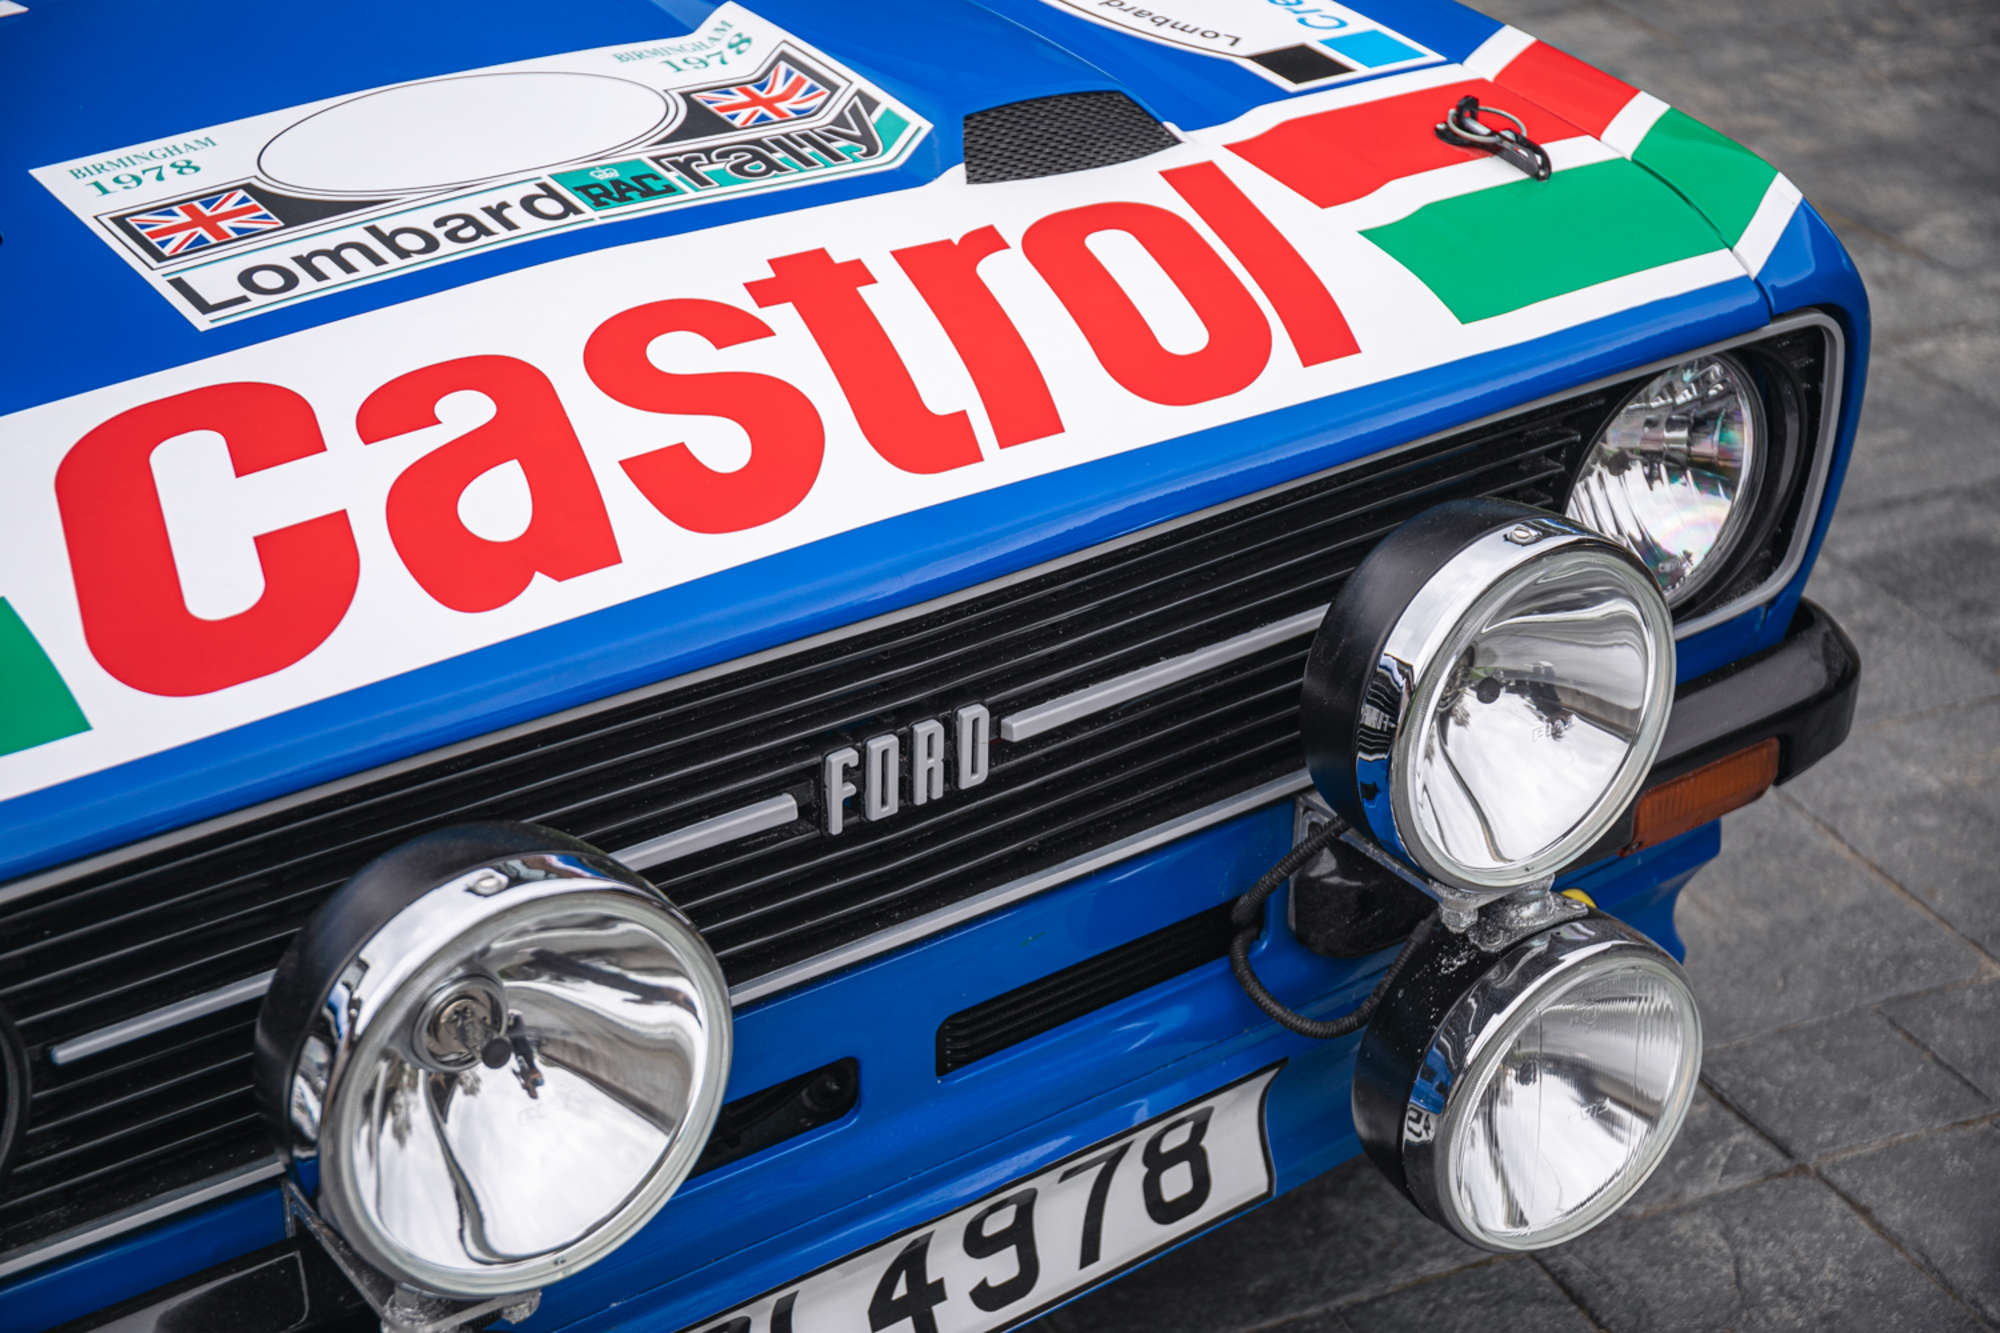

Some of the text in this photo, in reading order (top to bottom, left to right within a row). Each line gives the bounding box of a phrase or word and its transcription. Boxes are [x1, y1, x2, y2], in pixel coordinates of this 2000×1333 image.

[612, 20, 733, 63] BIRMINGHAM
[1099, 0, 1241, 46] Lombard
[660, 32, 752, 72] 1978
[68, 136, 218, 180] BIRMINGHAM
[86, 159, 202, 197] 1978
[166, 95, 885, 315] Lombard RAC rally
[55, 161, 1360, 696] Castrol
[825, 704, 990, 836] FORD
